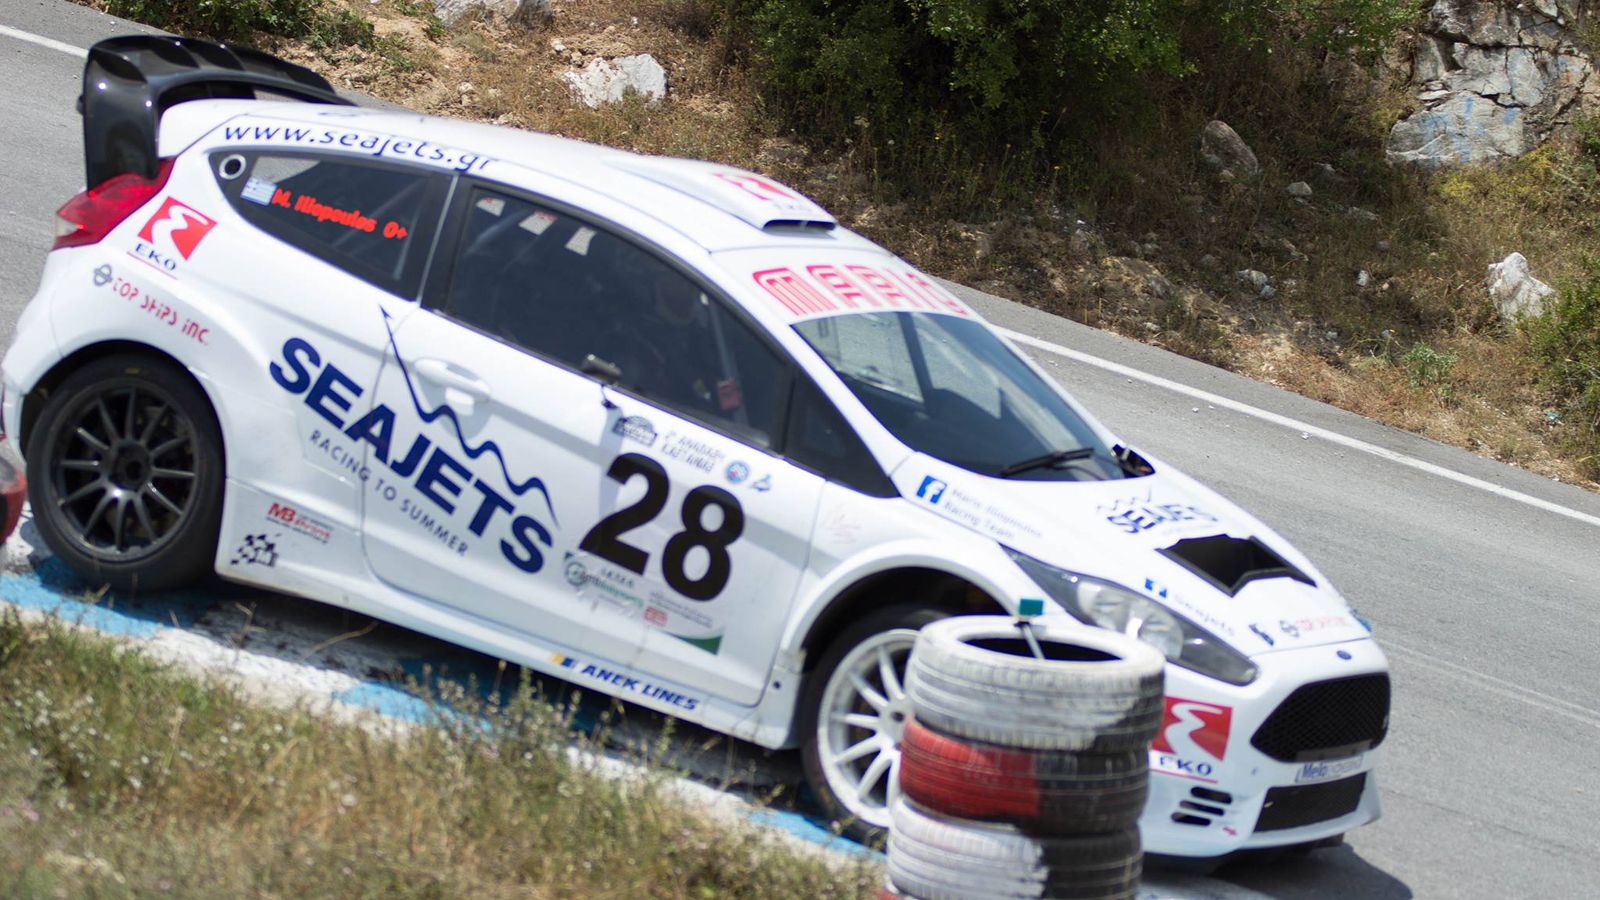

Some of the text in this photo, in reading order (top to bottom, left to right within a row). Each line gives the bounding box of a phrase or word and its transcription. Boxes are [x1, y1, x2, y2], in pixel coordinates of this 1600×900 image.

[224, 126, 497, 173] www.seajets.gr
[270, 187, 291, 209] M.
[134, 242, 178, 273] EKO
[112, 276, 140, 301] TOP
[269, 337, 553, 574] SEAJETS
[267, 502, 297, 523] MB
[308, 429, 469, 558] RACING TO SUMMER
[578, 452, 745, 602] 28
[581, 664, 701, 711] ANEK LINES
